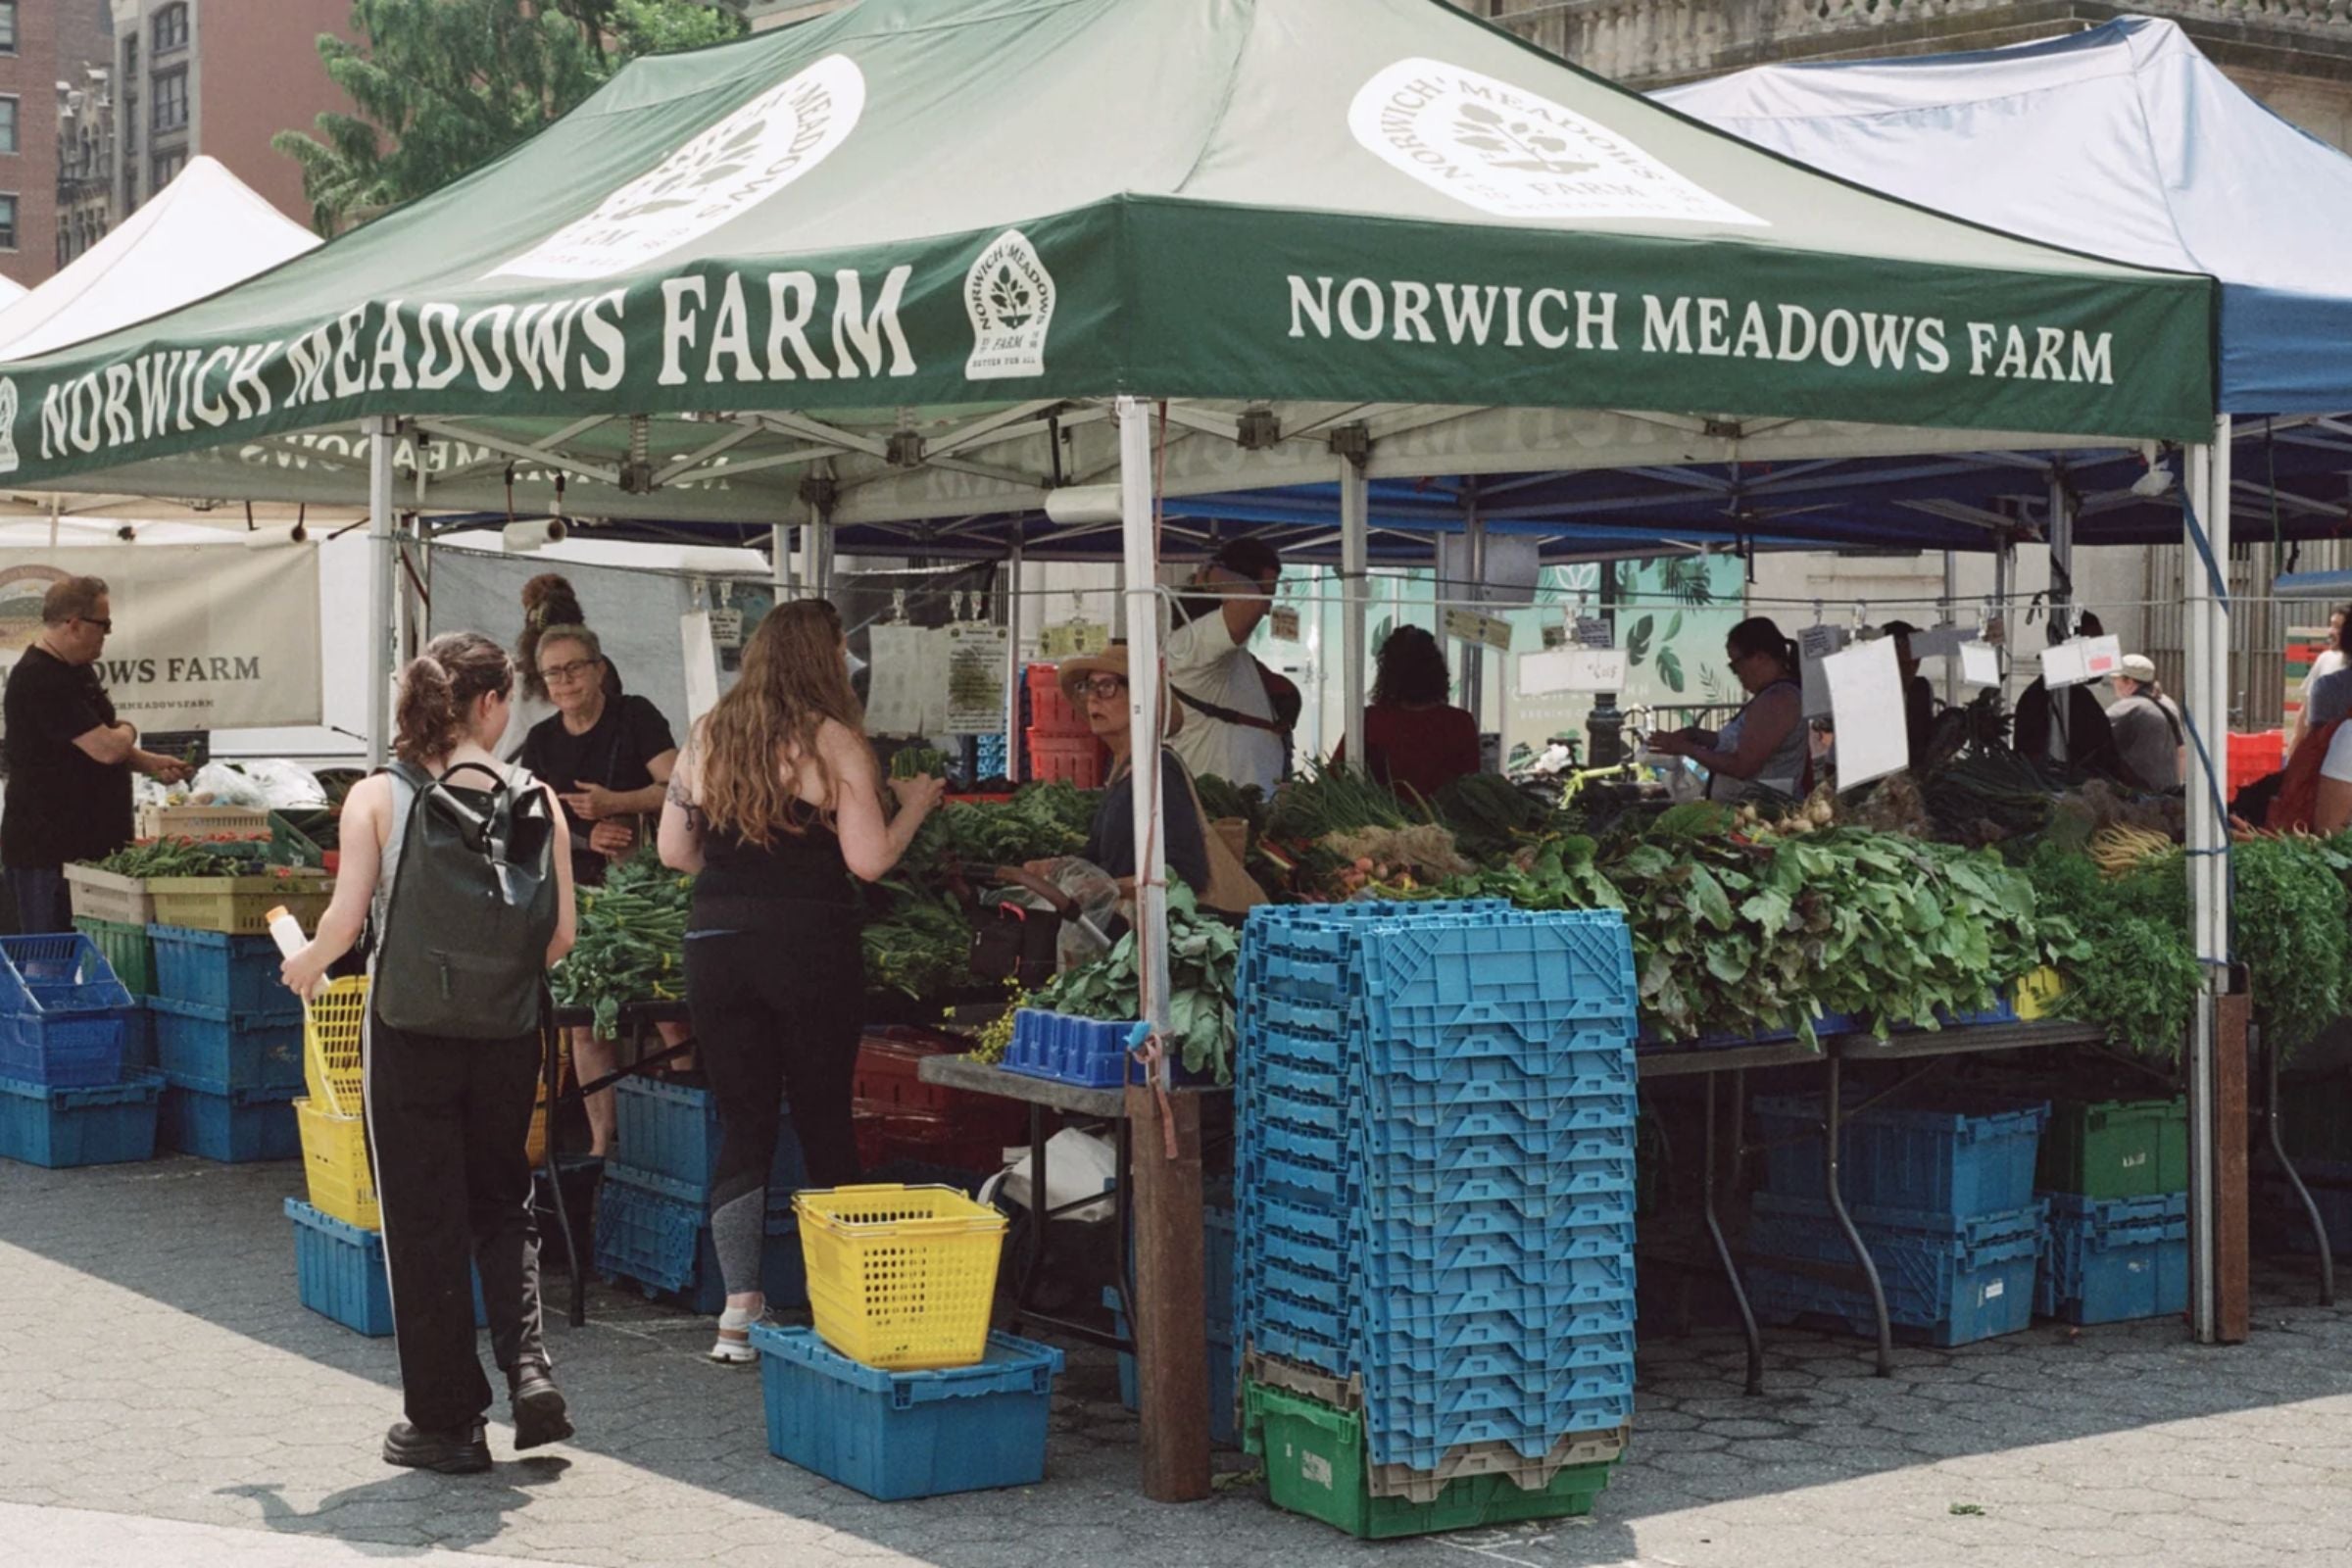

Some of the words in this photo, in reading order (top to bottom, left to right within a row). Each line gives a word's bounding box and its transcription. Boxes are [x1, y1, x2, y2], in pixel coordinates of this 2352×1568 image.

[971, 245, 1004, 330] NORWICH
[1287, 273, 1619, 351] NORWICH
[1641, 293, 1951, 374] MEADOWS
[1968, 320, 2114, 385] FARM
[41, 341, 282, 460] NORWICH
[285, 287, 628, 409] MEADOWS
[658, 264, 917, 386] FARM
[168, 656, 260, 682] FARM
